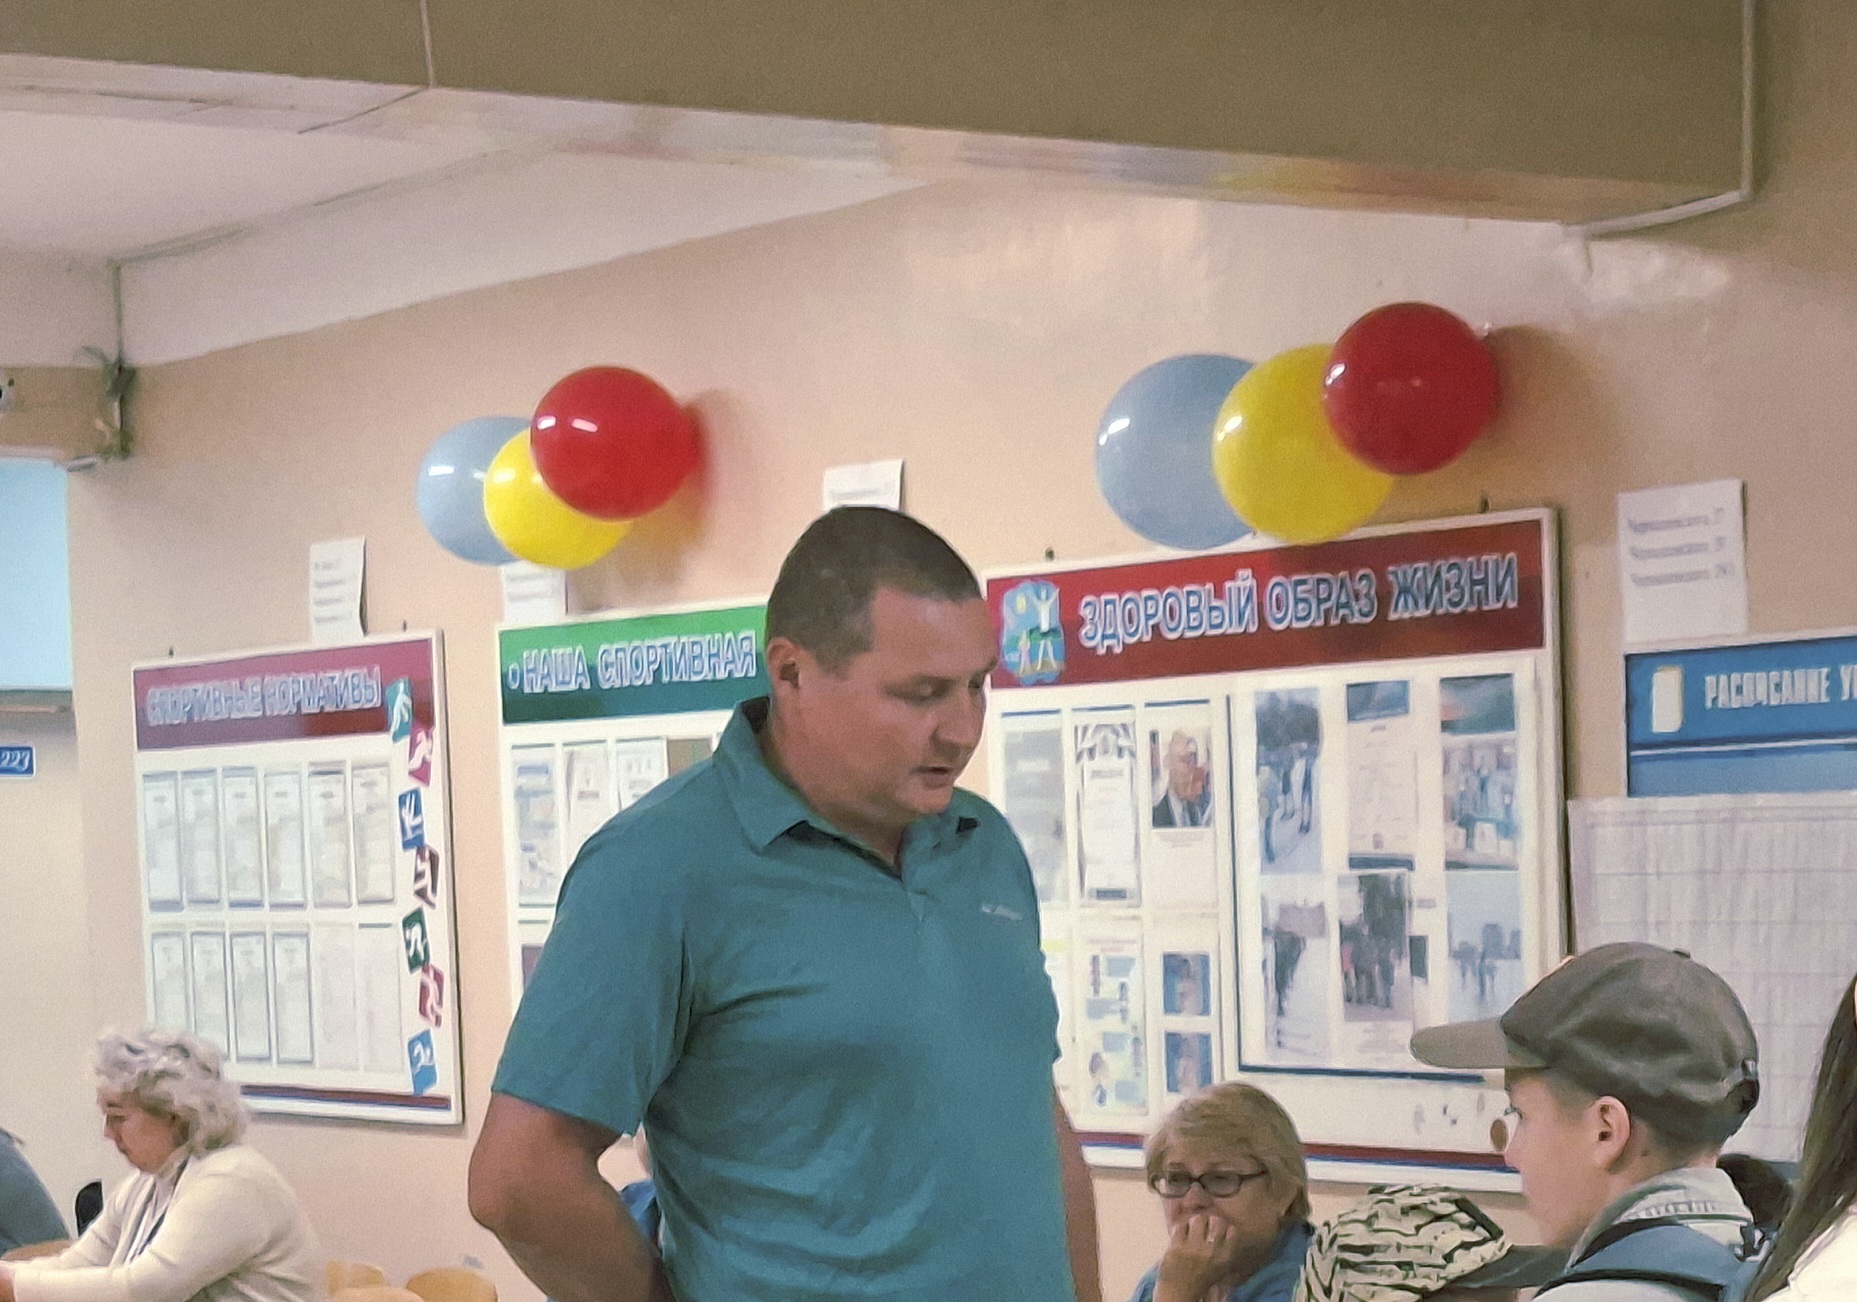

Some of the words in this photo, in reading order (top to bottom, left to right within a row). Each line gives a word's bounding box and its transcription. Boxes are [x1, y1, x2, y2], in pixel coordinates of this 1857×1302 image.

[1078, 568, 1259, 656] ЗДОРОВЫЙ
[1265, 568, 1378, 631] ОБРАЗ
[1388, 553, 1519, 621] ЖИЗНИ
[522, 644, 591, 694] НАША
[597, 630, 757, 690] СПОРТИВНАЯ
[1704, 667, 1831, 709] РАСПИСАНИЕ
